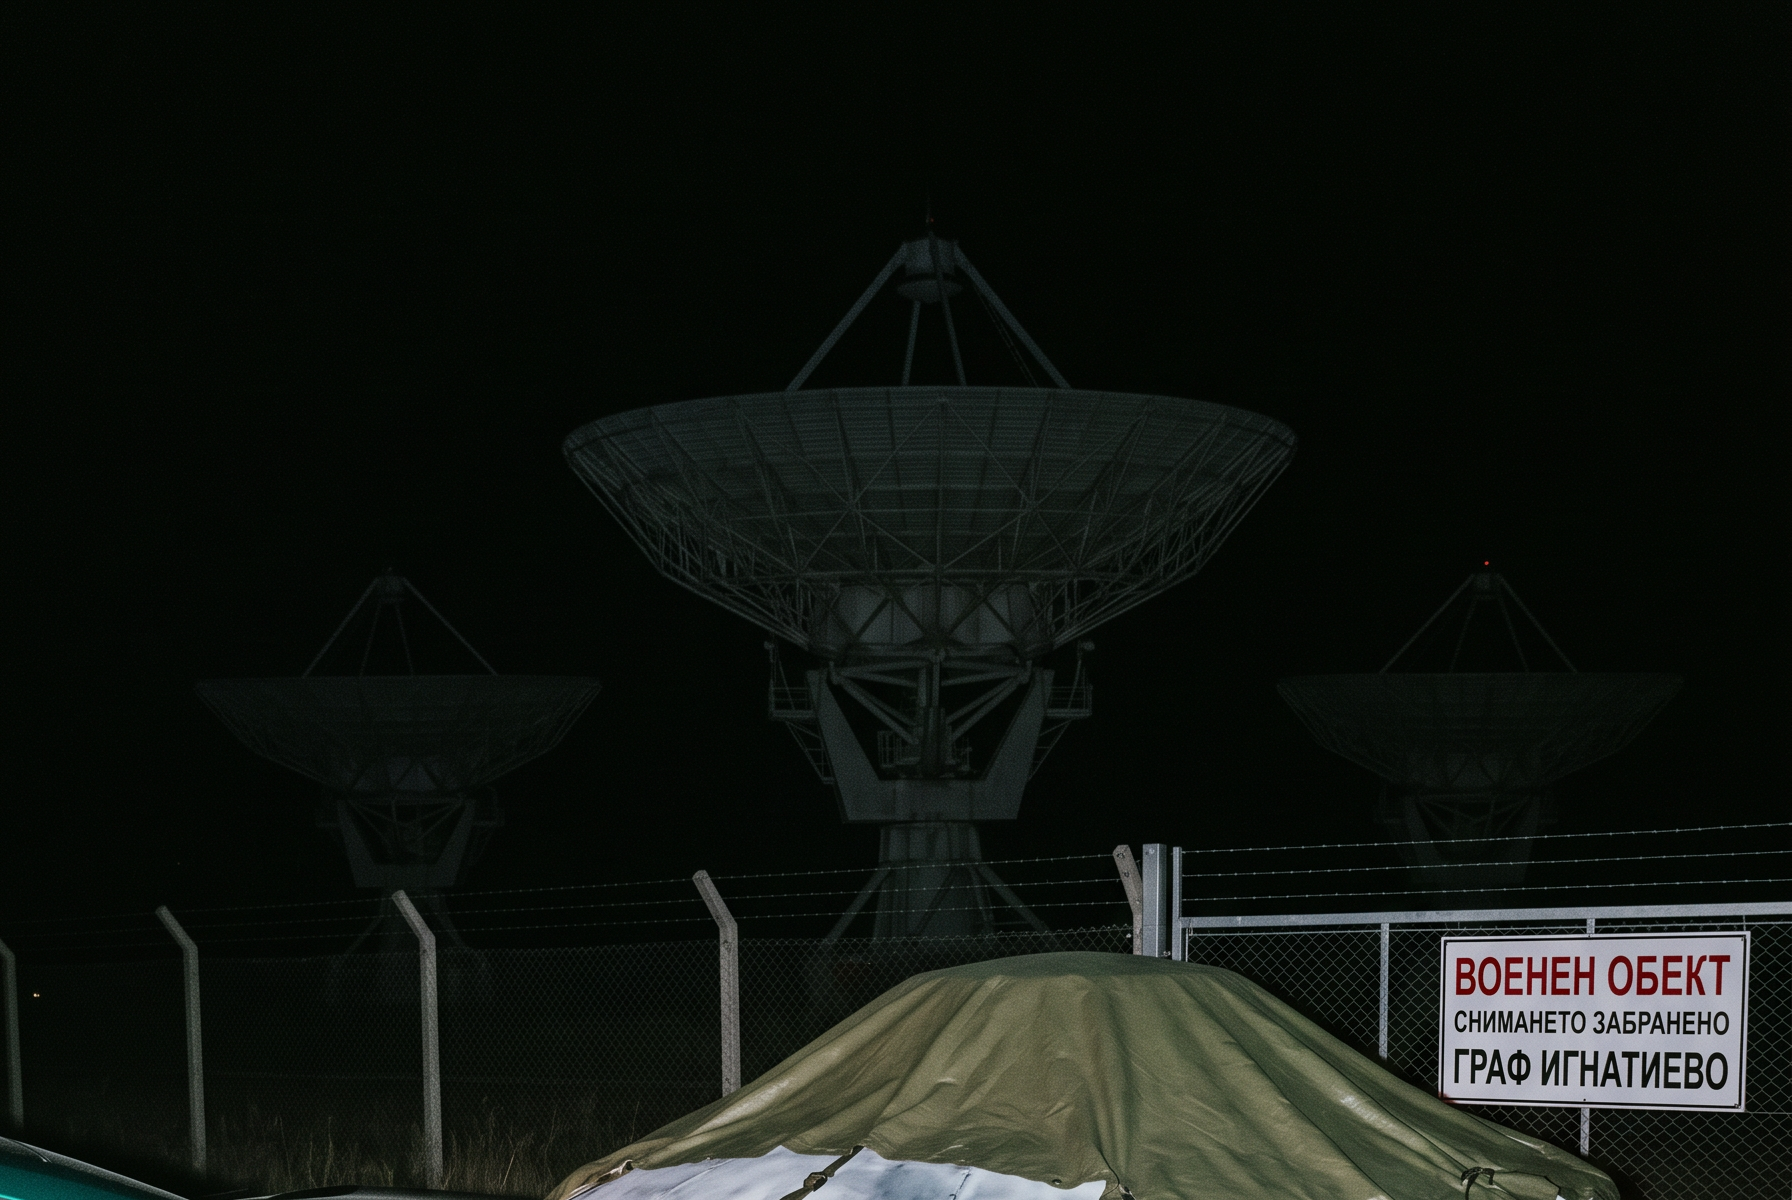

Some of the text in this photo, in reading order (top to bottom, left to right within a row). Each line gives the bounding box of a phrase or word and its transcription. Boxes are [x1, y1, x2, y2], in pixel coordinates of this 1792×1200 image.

[1456, 955, 1730, 996] ВОЕНЕН ОБЕКТ
[1455, 1010, 1729, 1035] СНИМАНЕТО ЗАБРАНЕНО
[1454, 1049, 1728, 1090] ГРАФ ИГНАТИЕВО
